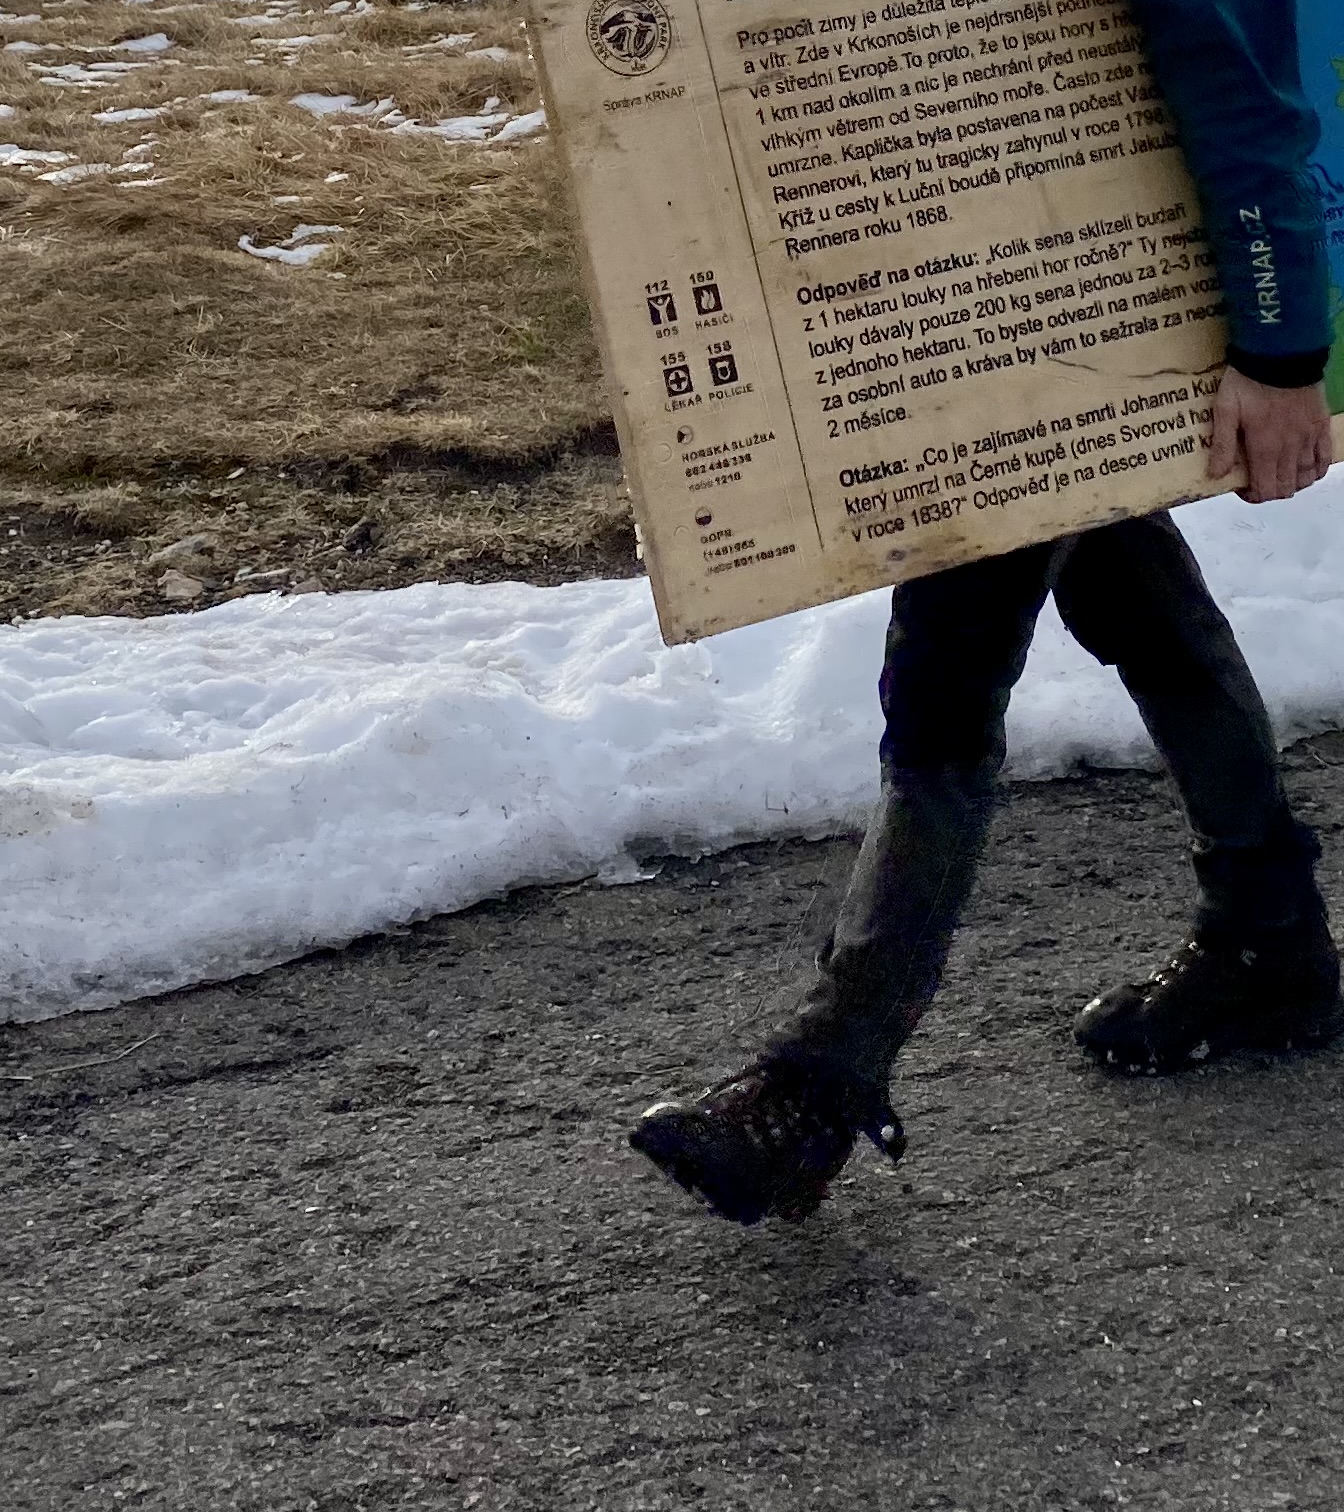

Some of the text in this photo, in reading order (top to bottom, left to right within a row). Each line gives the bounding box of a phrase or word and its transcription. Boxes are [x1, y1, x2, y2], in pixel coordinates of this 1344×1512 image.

[735, 25, 769, 49] Pro
[817, 10, 858, 37] zimy
[859, 6, 879, 29] je
[743, 60, 755, 74] a
[795, 43, 829, 64] Zde
[832, 43, 842, 56] v
[847, 22, 942, 54] Krkonoších
[944, 18, 961, 40] je
[964, 0, 1052, 33] nejdrsnější
[746, 84, 770, 100] ve
[774, 67, 833, 94] střední
[927, 44, 974, 68] proto,
[977, 37, 998, 54] že
[1001, 34, 1018, 50] to
[1021, 28, 1056, 51] jsou
[1058, 17, 1097, 42] hory
[644, 86, 686, 103] KRNAP
[760, 126, 822, 151] vlhkým
[825, 115, 884, 137] větrem
[888, 105, 911, 125] od
[913, 91, 999, 120] Severního
[1002, 80, 1049, 102] moře.
[1050, 63, 1102, 93] Často
[1103, 65, 1133, 83] zde
[769, 47, 1074, 122] km nad okolím a nic je nechrání před
[767, 90, 1123, 177] umrzne. Kaplička byla postavena na počest
[772, 119, 1119, 204] Rennerovi, který tu tragicky zahynul v roce
[777, 141, 1125, 230] Kříž u cesty k Luční boudě připomíná smrt
[784, 204, 953, 258] Rennera roku 1868.
[796, 269, 881, 305] Odpověď
[886, 268, 910, 284] na
[913, 252, 979, 278] otázku:
[1033, 230, 1074, 251] sena
[1078, 213, 1133, 240] sklízeli
[1135, 202, 1185, 227] budaři
[644, 279, 670, 294] 112
[807, 264, 1156, 358] louky dávaly pouze 200 kg sena jednou za
[833, 257, 1071, 325] hektaru louky na hřebeni hor
[820, 315, 1159, 412] za osobní auto kráva by vám to sežrala
[828, 284, 1186, 386] jednoho hektaru. byste odvezli na malém
[838, 387, 1188, 487] Otázka: „Co zajímavé na smrti Johanna
[844, 488, 887, 520] který
[892, 474, 939, 504] umrzl
[943, 472, 967, 489] na
[969, 452, 1022, 481] Černé
[1024, 441, 1067, 468] kupě
[1070, 433, 1116, 460] (dnes
[1119, 410, 1186, 442] Svorová
[865, 517, 906, 539] roce
[973, 473, 1049, 509] Odpověď
[1073, 465, 1096, 483] na
[1098, 452, 1148, 475] desce
[1151, 434, 1194, 461] uvnitř
